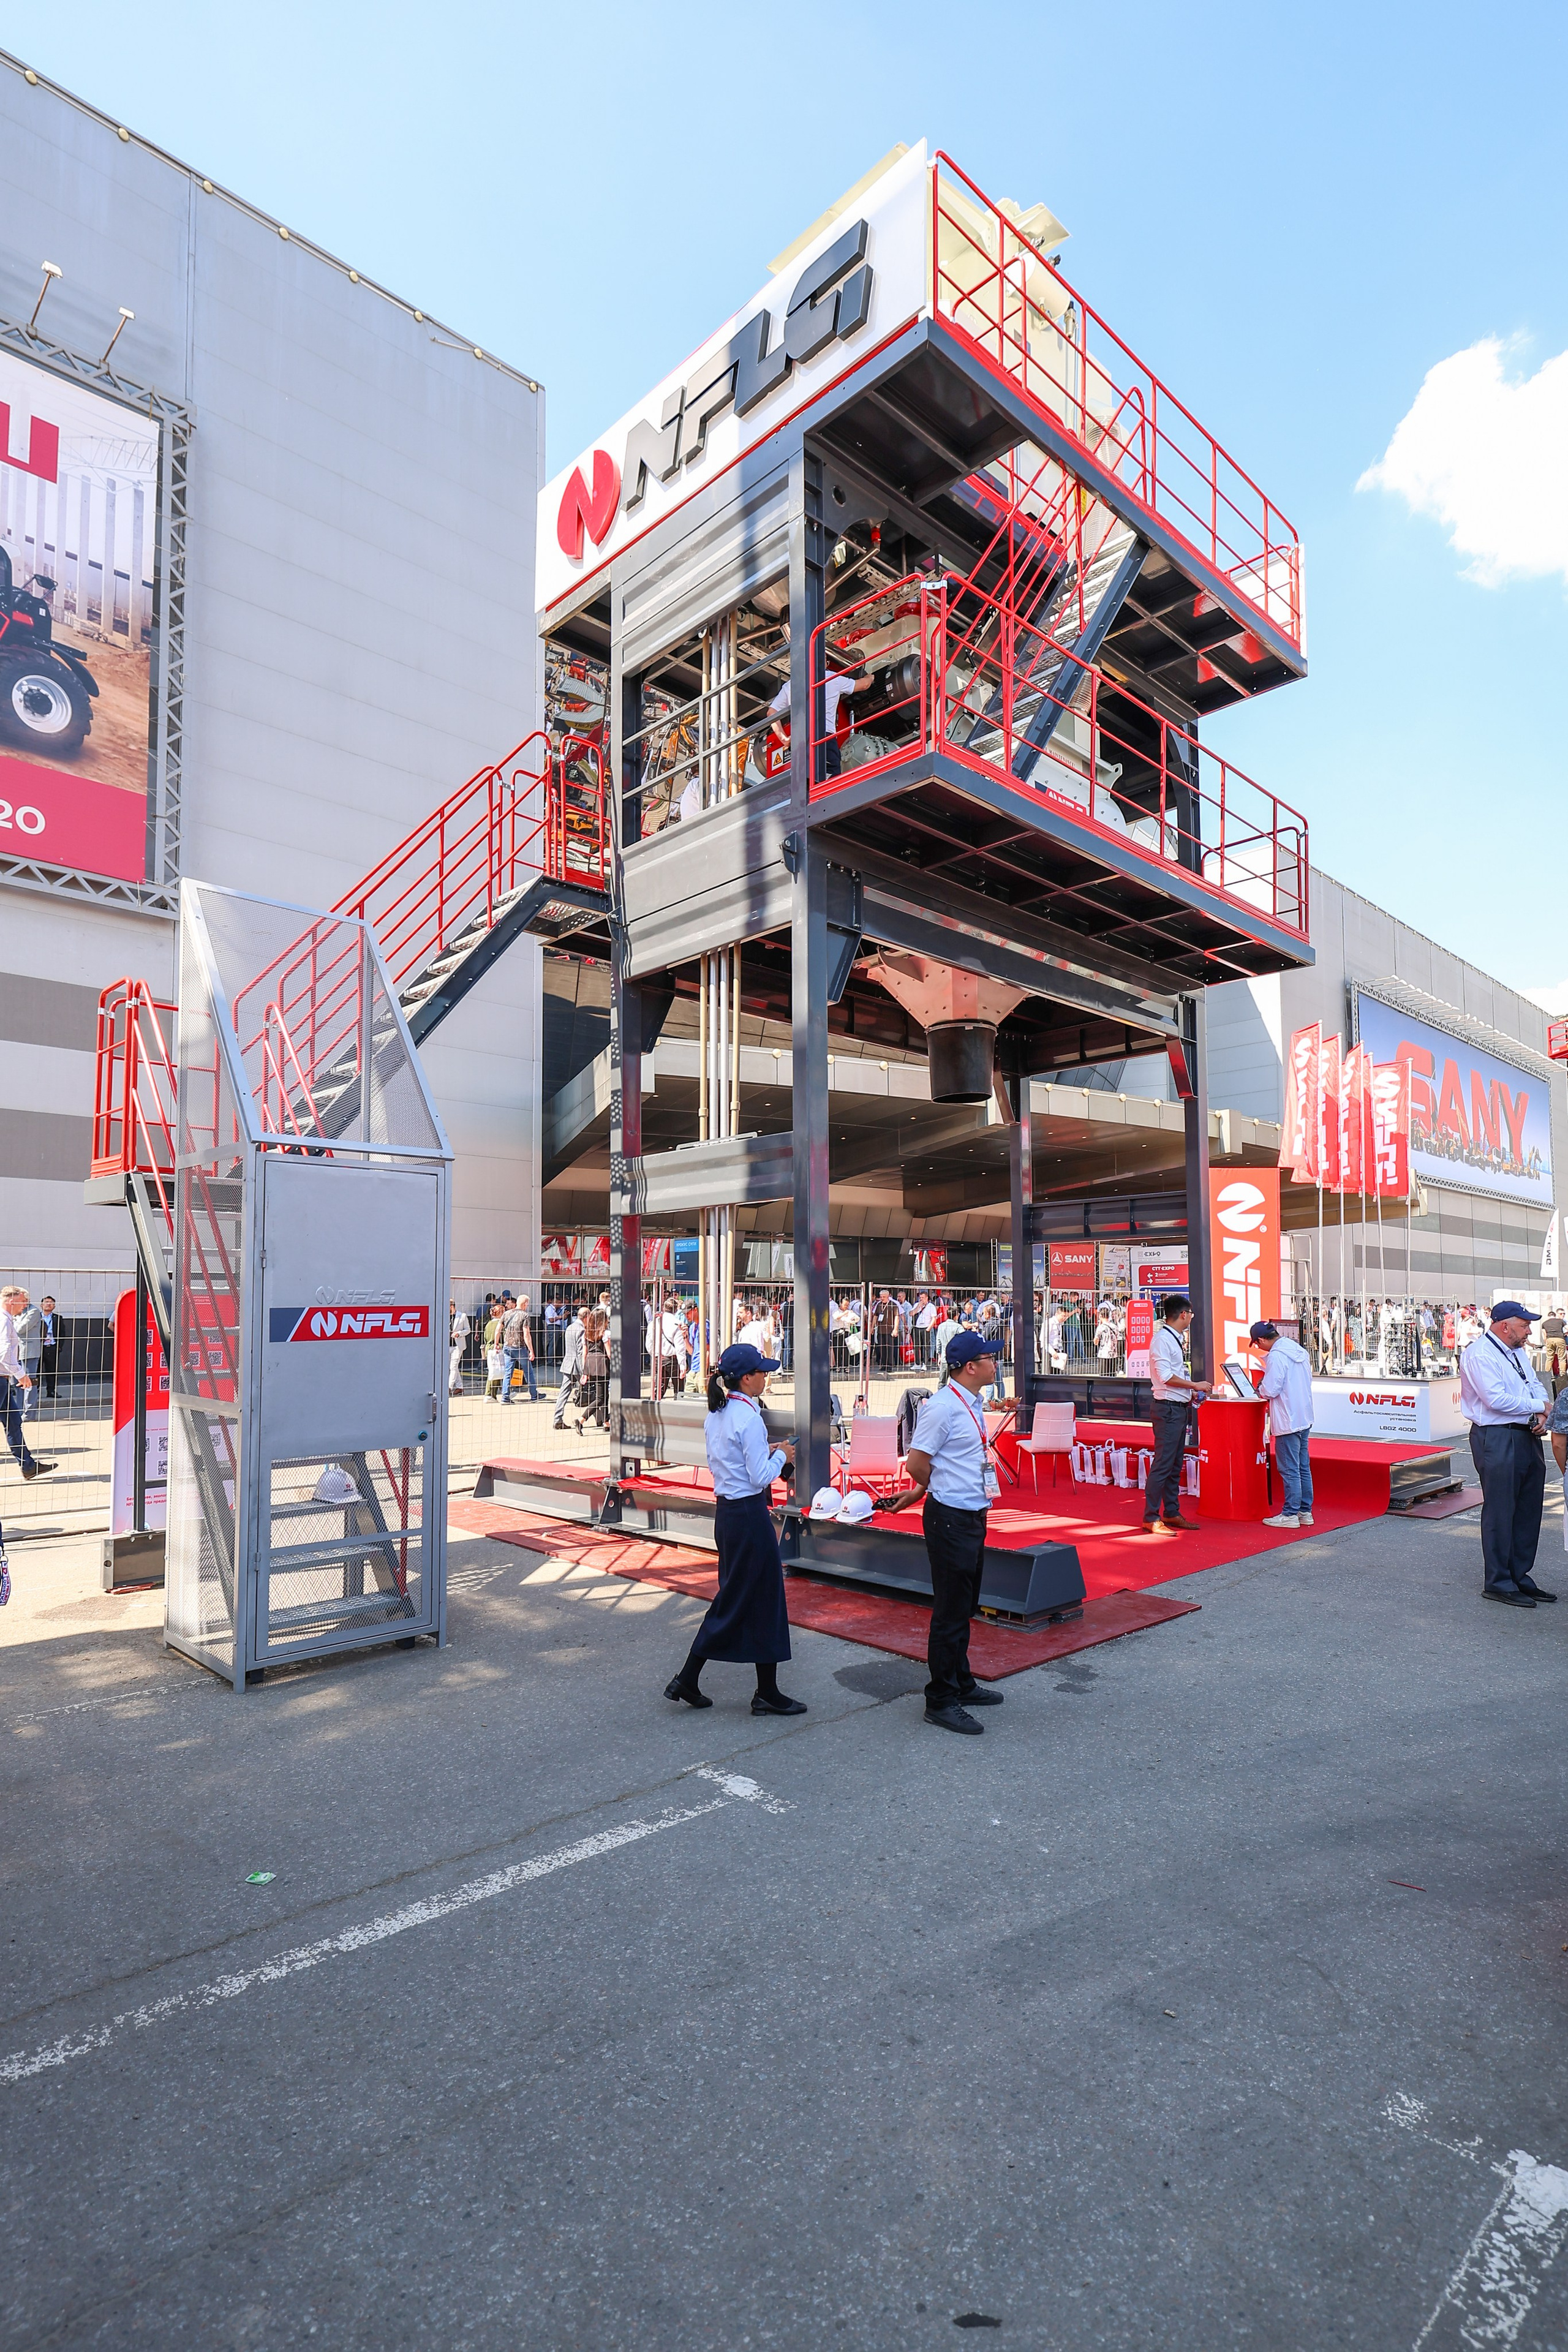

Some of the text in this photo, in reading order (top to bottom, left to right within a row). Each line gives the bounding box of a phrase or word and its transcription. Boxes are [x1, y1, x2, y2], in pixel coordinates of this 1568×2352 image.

[622, 218, 875, 511] NFLG
[1395, 1039, 1529, 1166] SANY
[1065, 1254, 1093, 1264] SANY
[335, 1289, 396, 1305] NFLG
[340, 1313, 422, 1334] NFLG
[1366, 1394, 1415, 1408] NFLG
